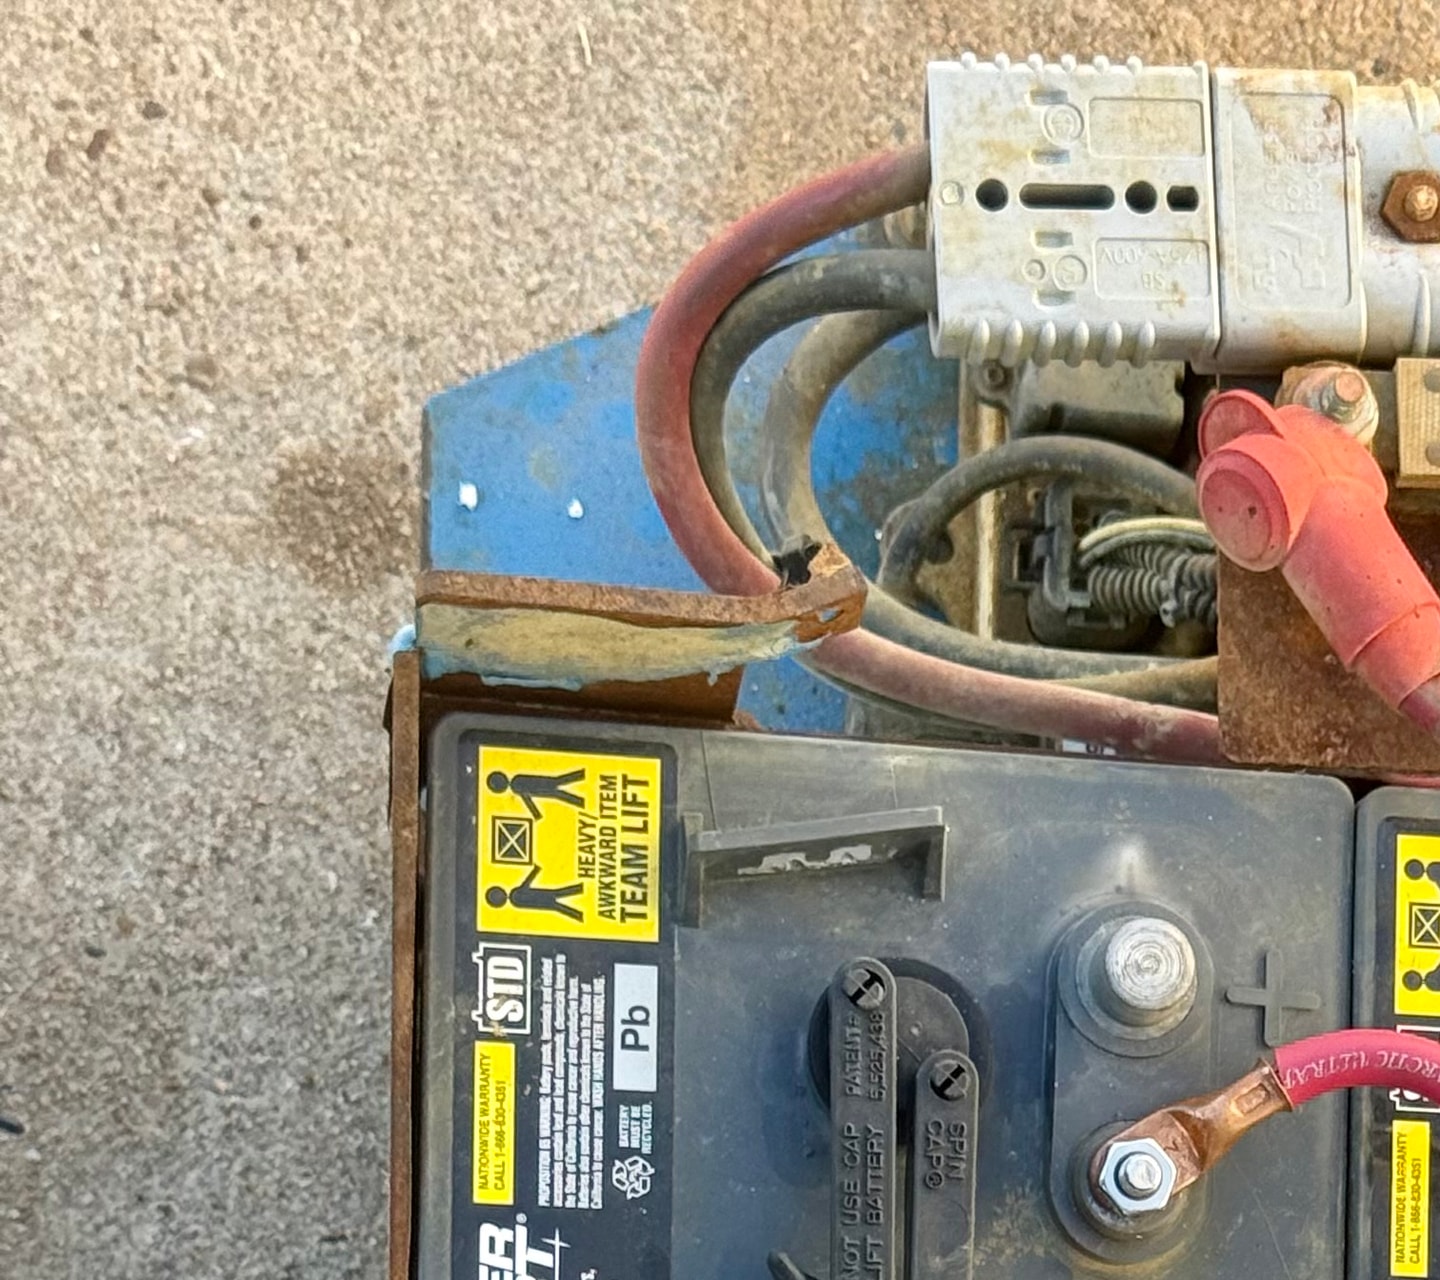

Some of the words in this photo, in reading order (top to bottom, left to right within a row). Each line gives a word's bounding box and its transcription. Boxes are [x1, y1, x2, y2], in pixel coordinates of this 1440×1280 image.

[599, 775, 617, 820] ITEM
[621, 773, 649, 834] LIFT
[578, 811, 598, 879] HEAVY/
[598, 826, 617, 921] AWKWARD
[620, 843, 649, 924] TEAM
[486, 955, 524, 1023] STD
[621, 1005, 651, 1051] Pb
[478, 1053, 492, 1117] WARRANTY
[478, 1119, 491, 1191] NATIONWIDE
[493, 1161, 505, 1191] CALL
[843, 1121, 861, 1172] CAP
[866, 1123, 885, 1226] BATTERY
[1395, 1132, 1408, 1194] WARRANTY
[842, 1179, 861, 1227] USE
[1395, 1197, 1407, 1265] NATIONWIDE
[1409, 1235, 1422, 1265] CALL
